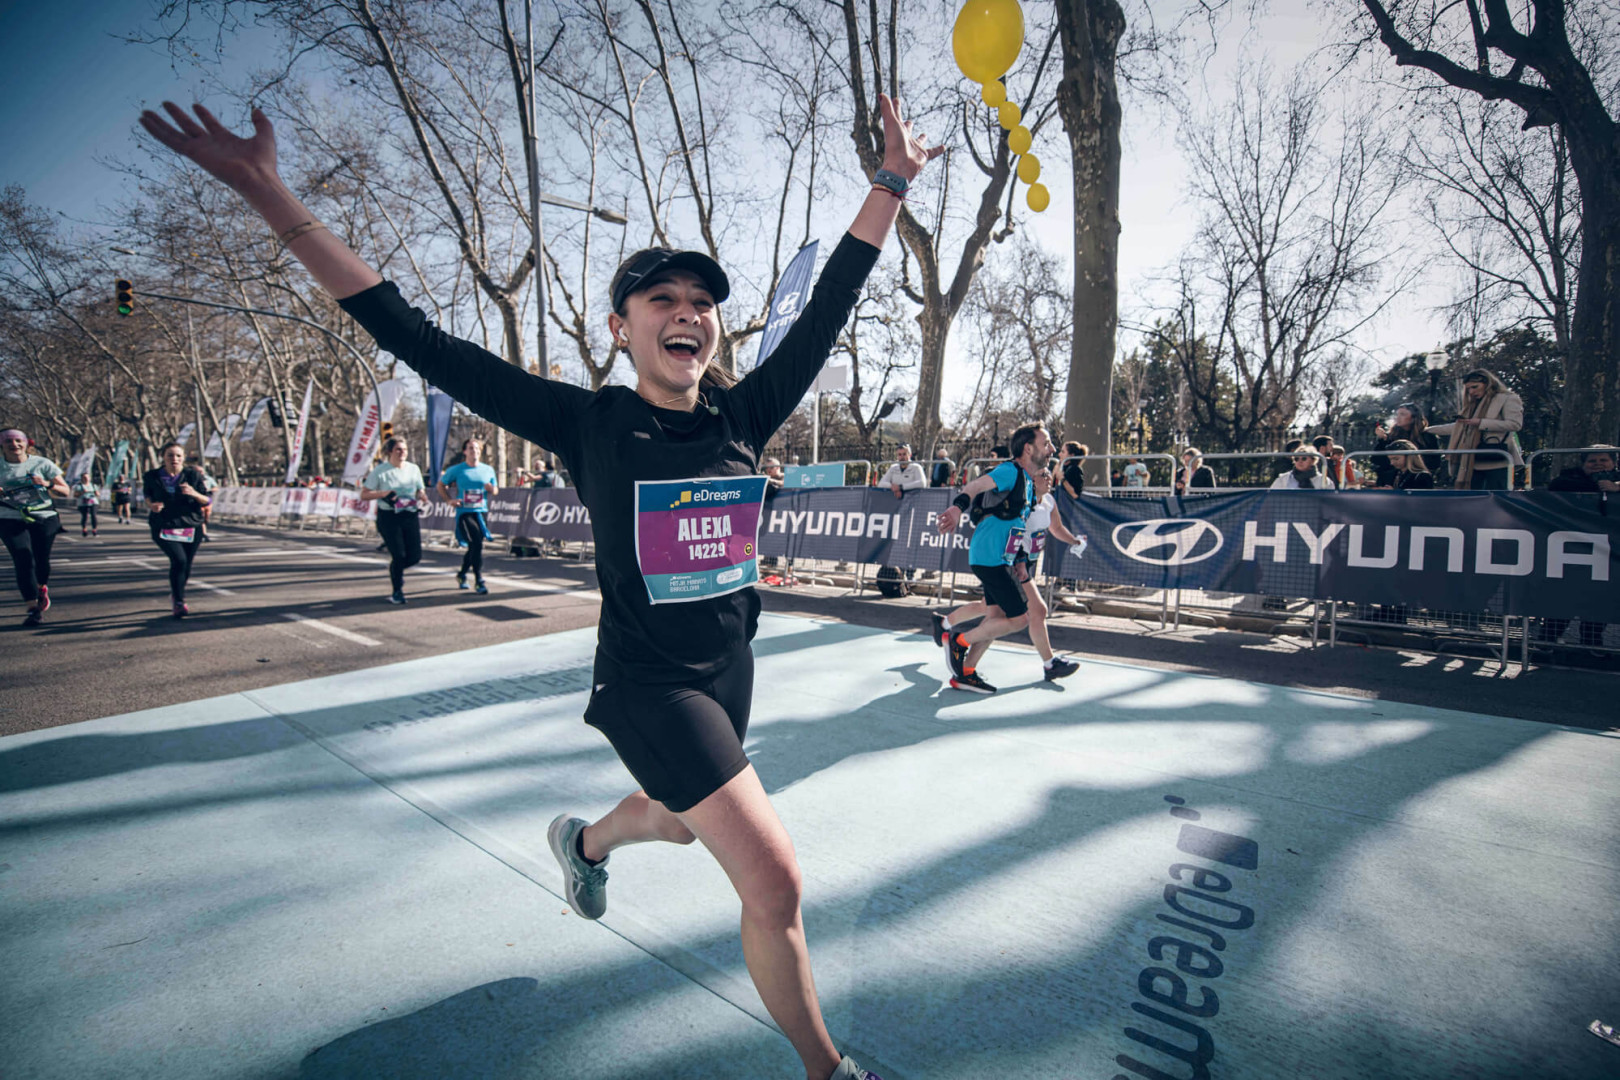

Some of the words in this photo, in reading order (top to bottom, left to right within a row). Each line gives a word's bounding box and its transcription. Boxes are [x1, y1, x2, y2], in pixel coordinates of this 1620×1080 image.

[357, 404, 379, 451] YAMAHA
[693, 489, 741, 502] eDreams
[677, 514, 733, 542] ALEXA
[768, 510, 901, 540] HYUNDAI
[688, 542, 726, 560] 14229
[920, 531, 950, 548] Full
[1113, 863, 1255, 1080] eDream
